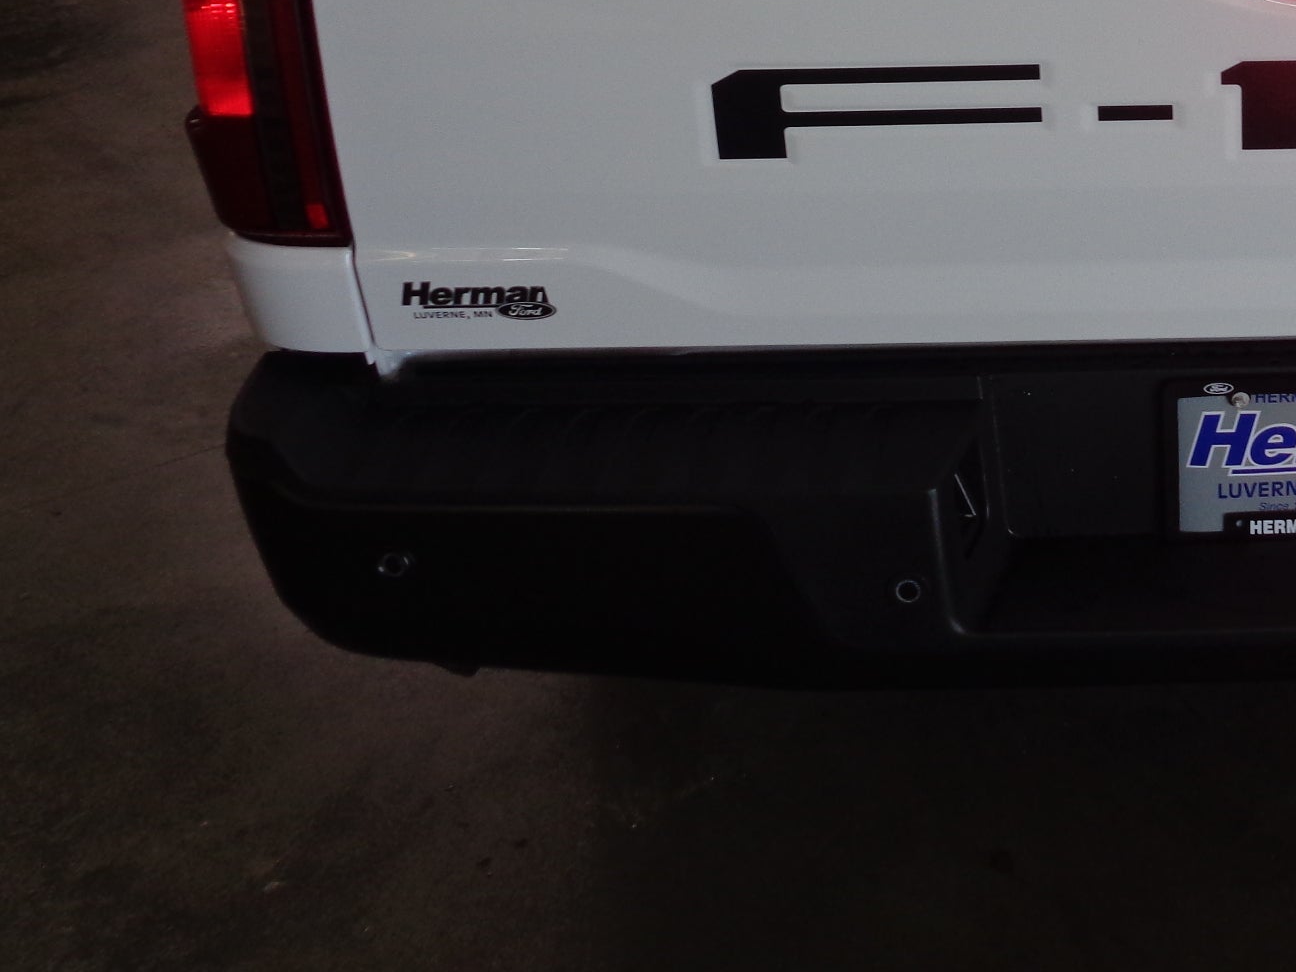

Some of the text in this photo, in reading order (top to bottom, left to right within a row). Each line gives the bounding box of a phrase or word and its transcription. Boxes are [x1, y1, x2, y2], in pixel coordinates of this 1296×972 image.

[402, 281, 549, 305] Herman
[413, 310, 493, 320] LUVERNE, MN
[508, 304, 542, 316] Ford
